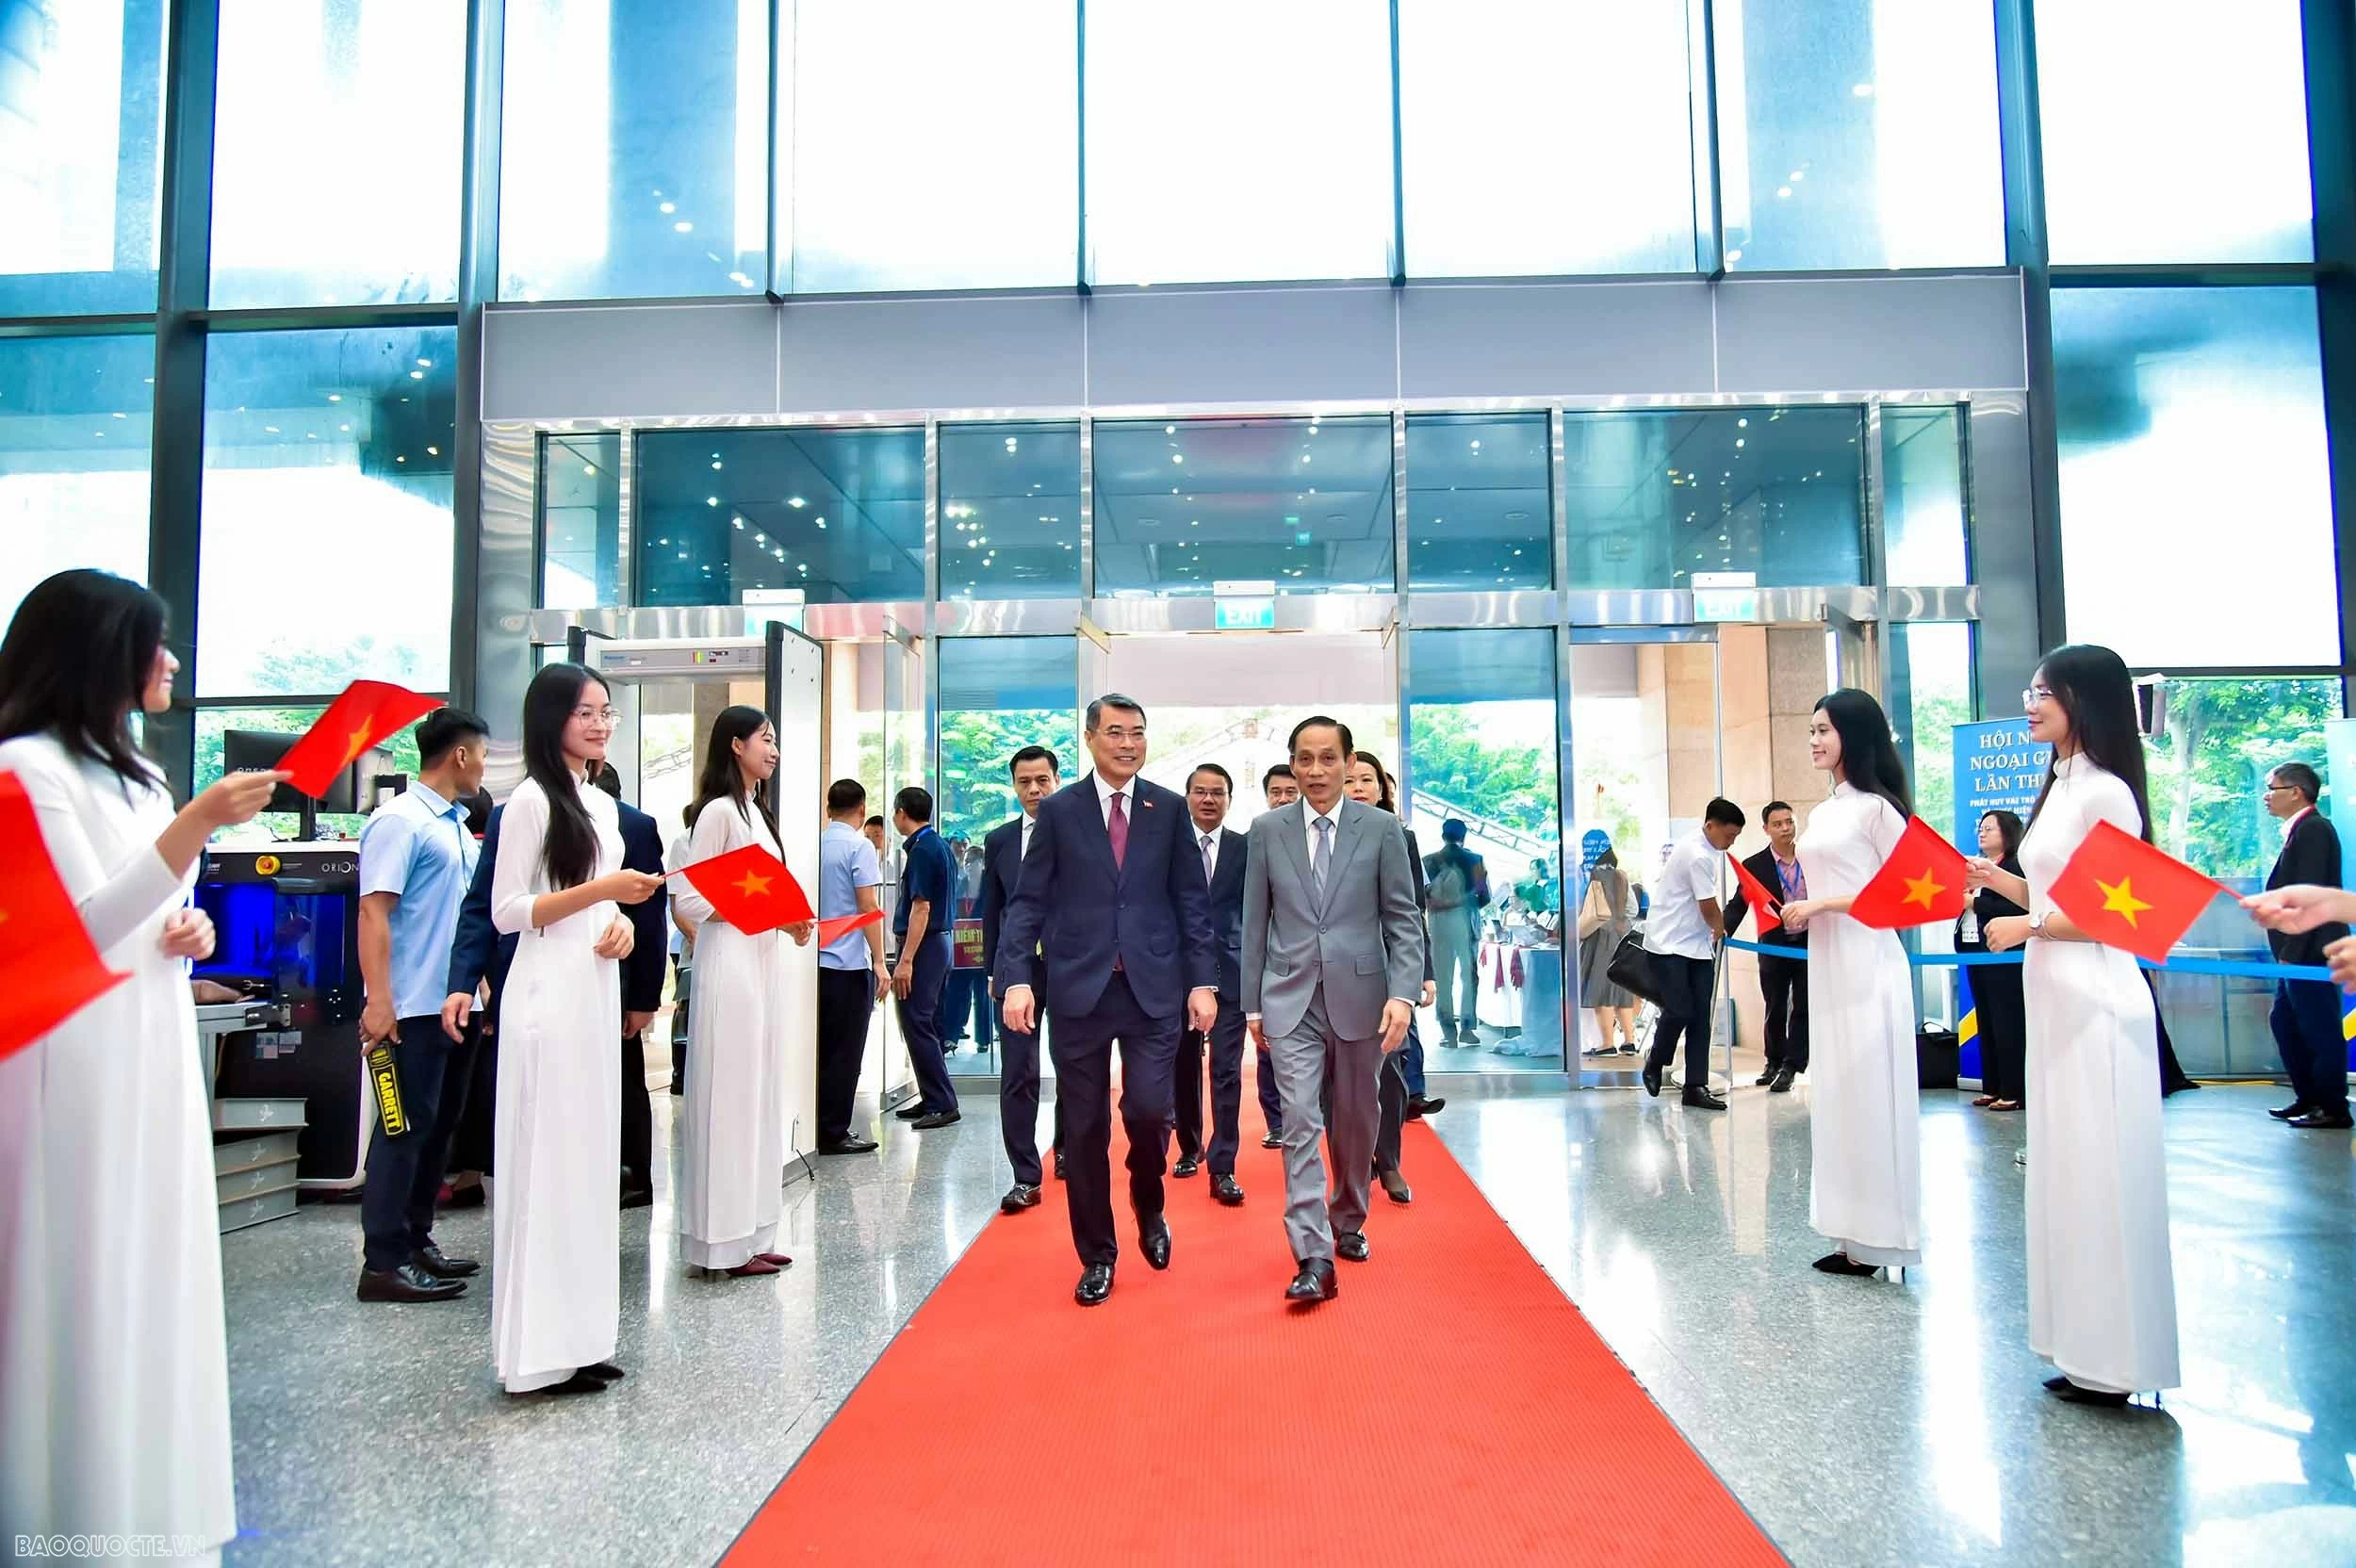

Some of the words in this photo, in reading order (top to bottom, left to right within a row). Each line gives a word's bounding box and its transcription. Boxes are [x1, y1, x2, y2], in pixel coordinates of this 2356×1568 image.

[1980, 729, 2013, 750] HỘI
[1971, 752, 2028, 770] NGOẠI
[1975, 774, 2009, 792] LẦN
[321, 861, 359, 874] ORION
[378, 1072, 401, 1128] GARRETT
